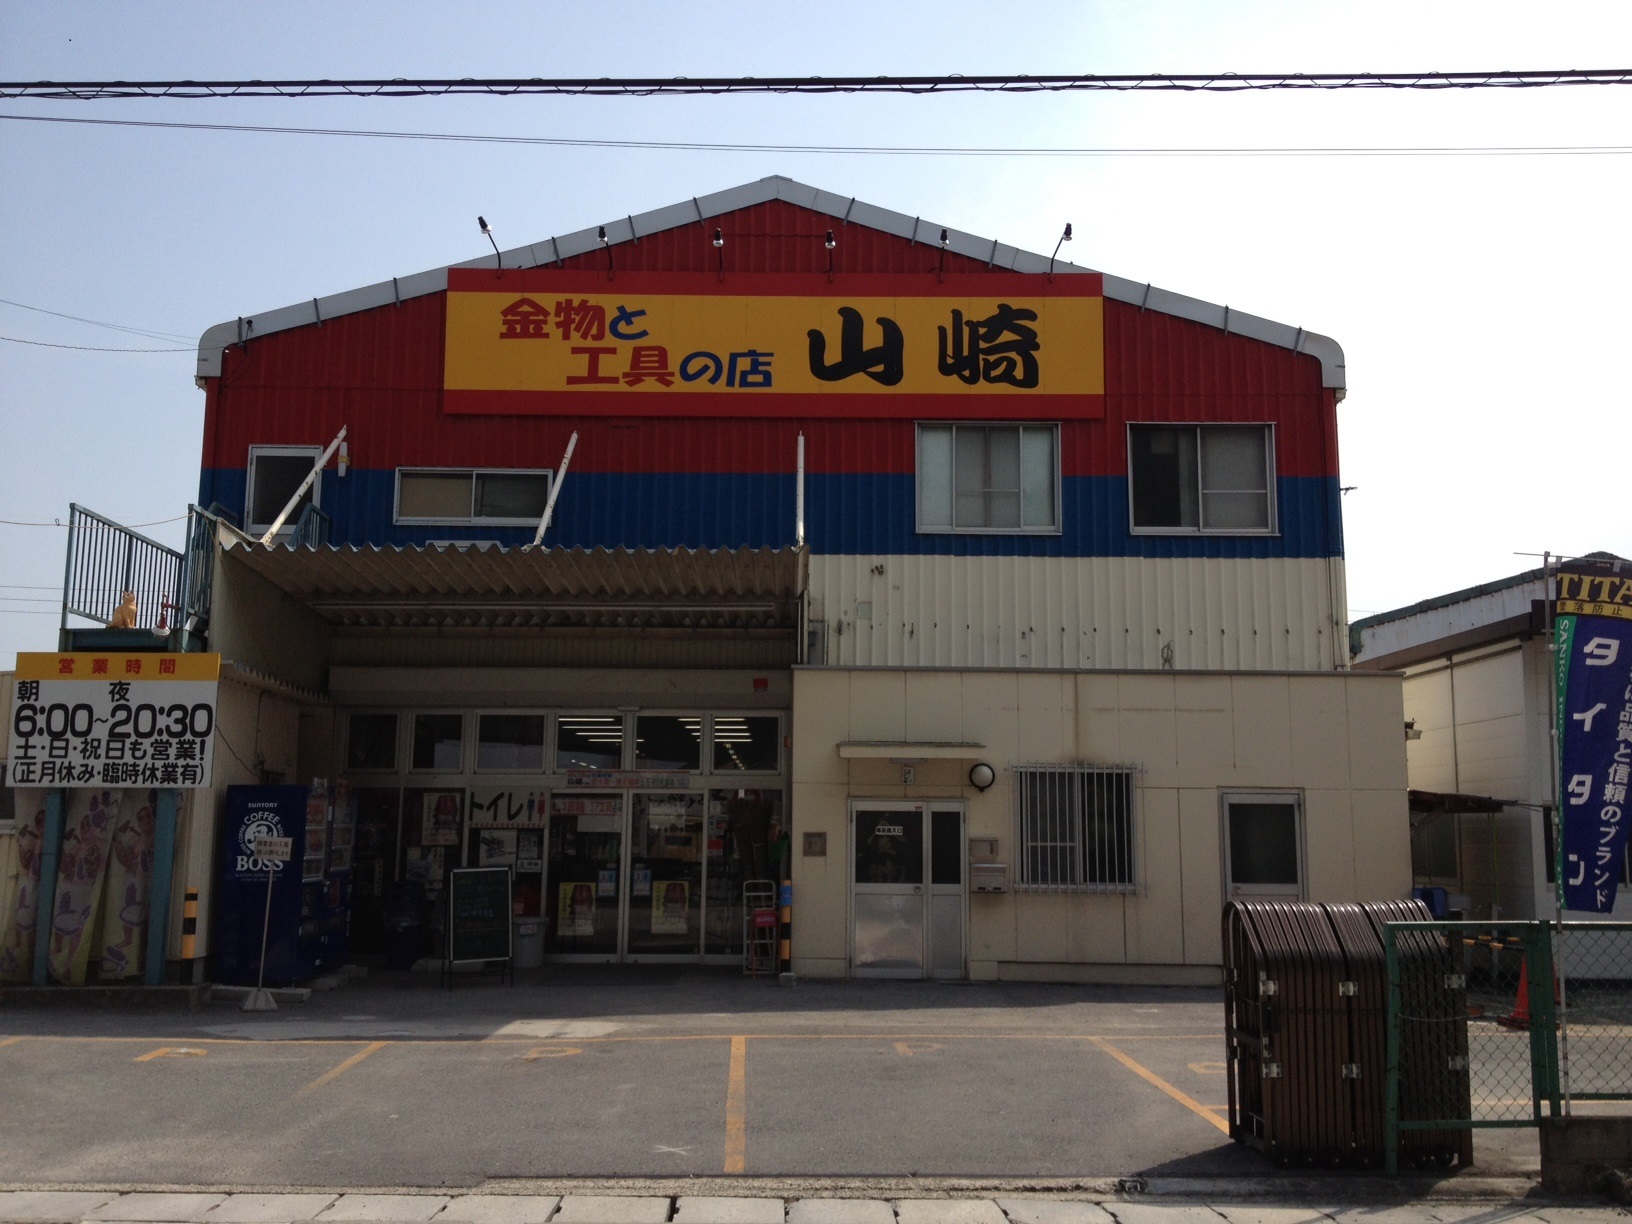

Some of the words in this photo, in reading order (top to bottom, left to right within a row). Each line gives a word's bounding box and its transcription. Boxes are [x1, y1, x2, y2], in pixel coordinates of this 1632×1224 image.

[499, 298, 649, 342] 金物と
[566, 345, 774, 388] 工具の店
[59, 658, 176, 675] 営業時間
[17, 681, 40, 702] 朝
[109, 681, 131, 703] 夜
[244, 811, 280, 825] COFFEE
[469, 792, 524, 822] トイレ
[236, 856, 283, 871] BOSS
